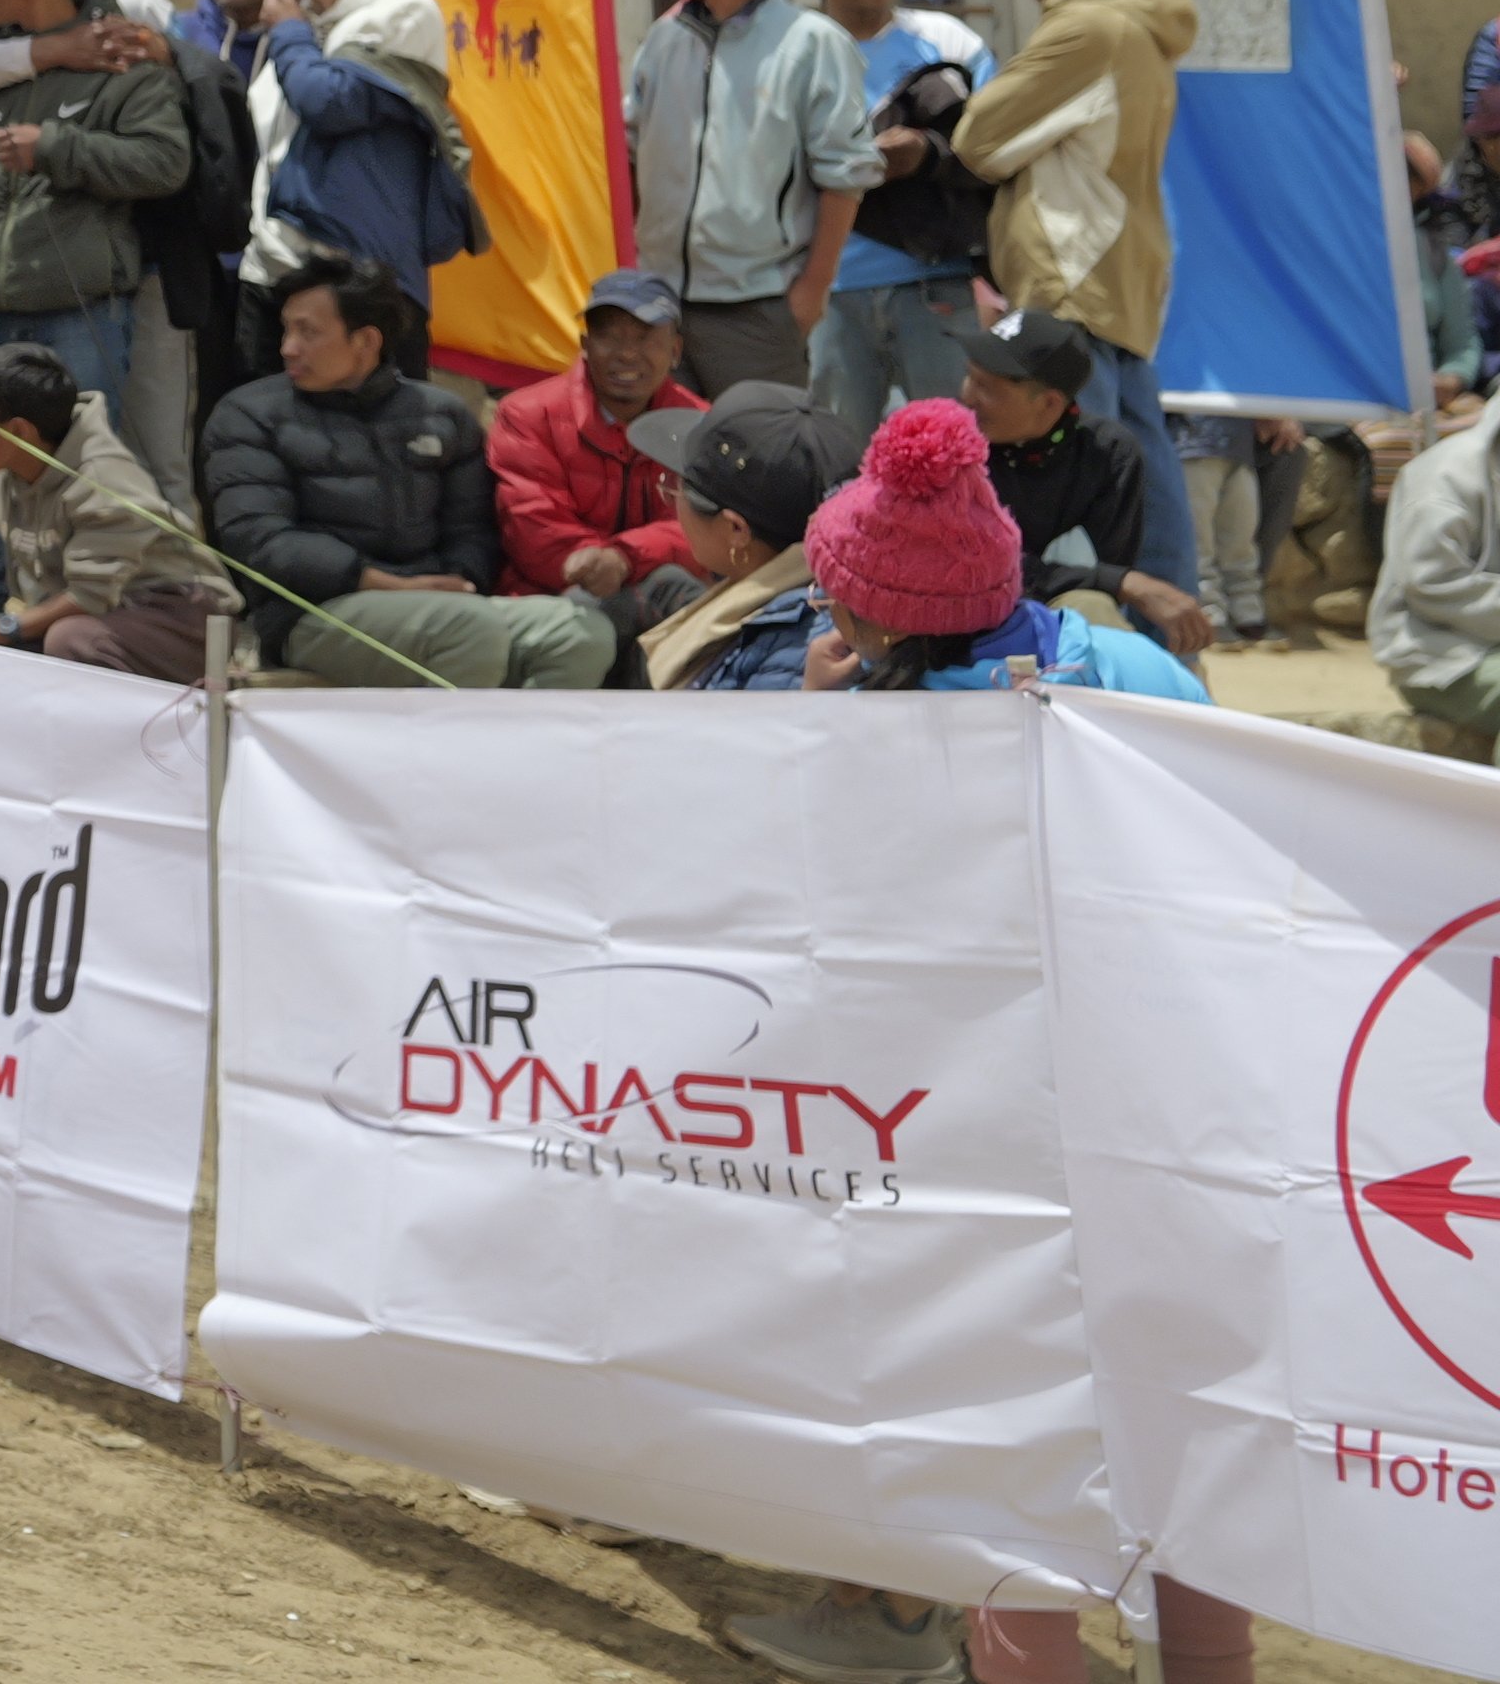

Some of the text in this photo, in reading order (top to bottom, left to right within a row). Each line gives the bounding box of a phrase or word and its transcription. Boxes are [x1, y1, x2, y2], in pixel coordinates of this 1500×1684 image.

[402, 976, 538, 1050] AIR
[401, 1042, 931, 1163] DYNASTY
[531, 1137, 902, 1207] HELI SERVICES
